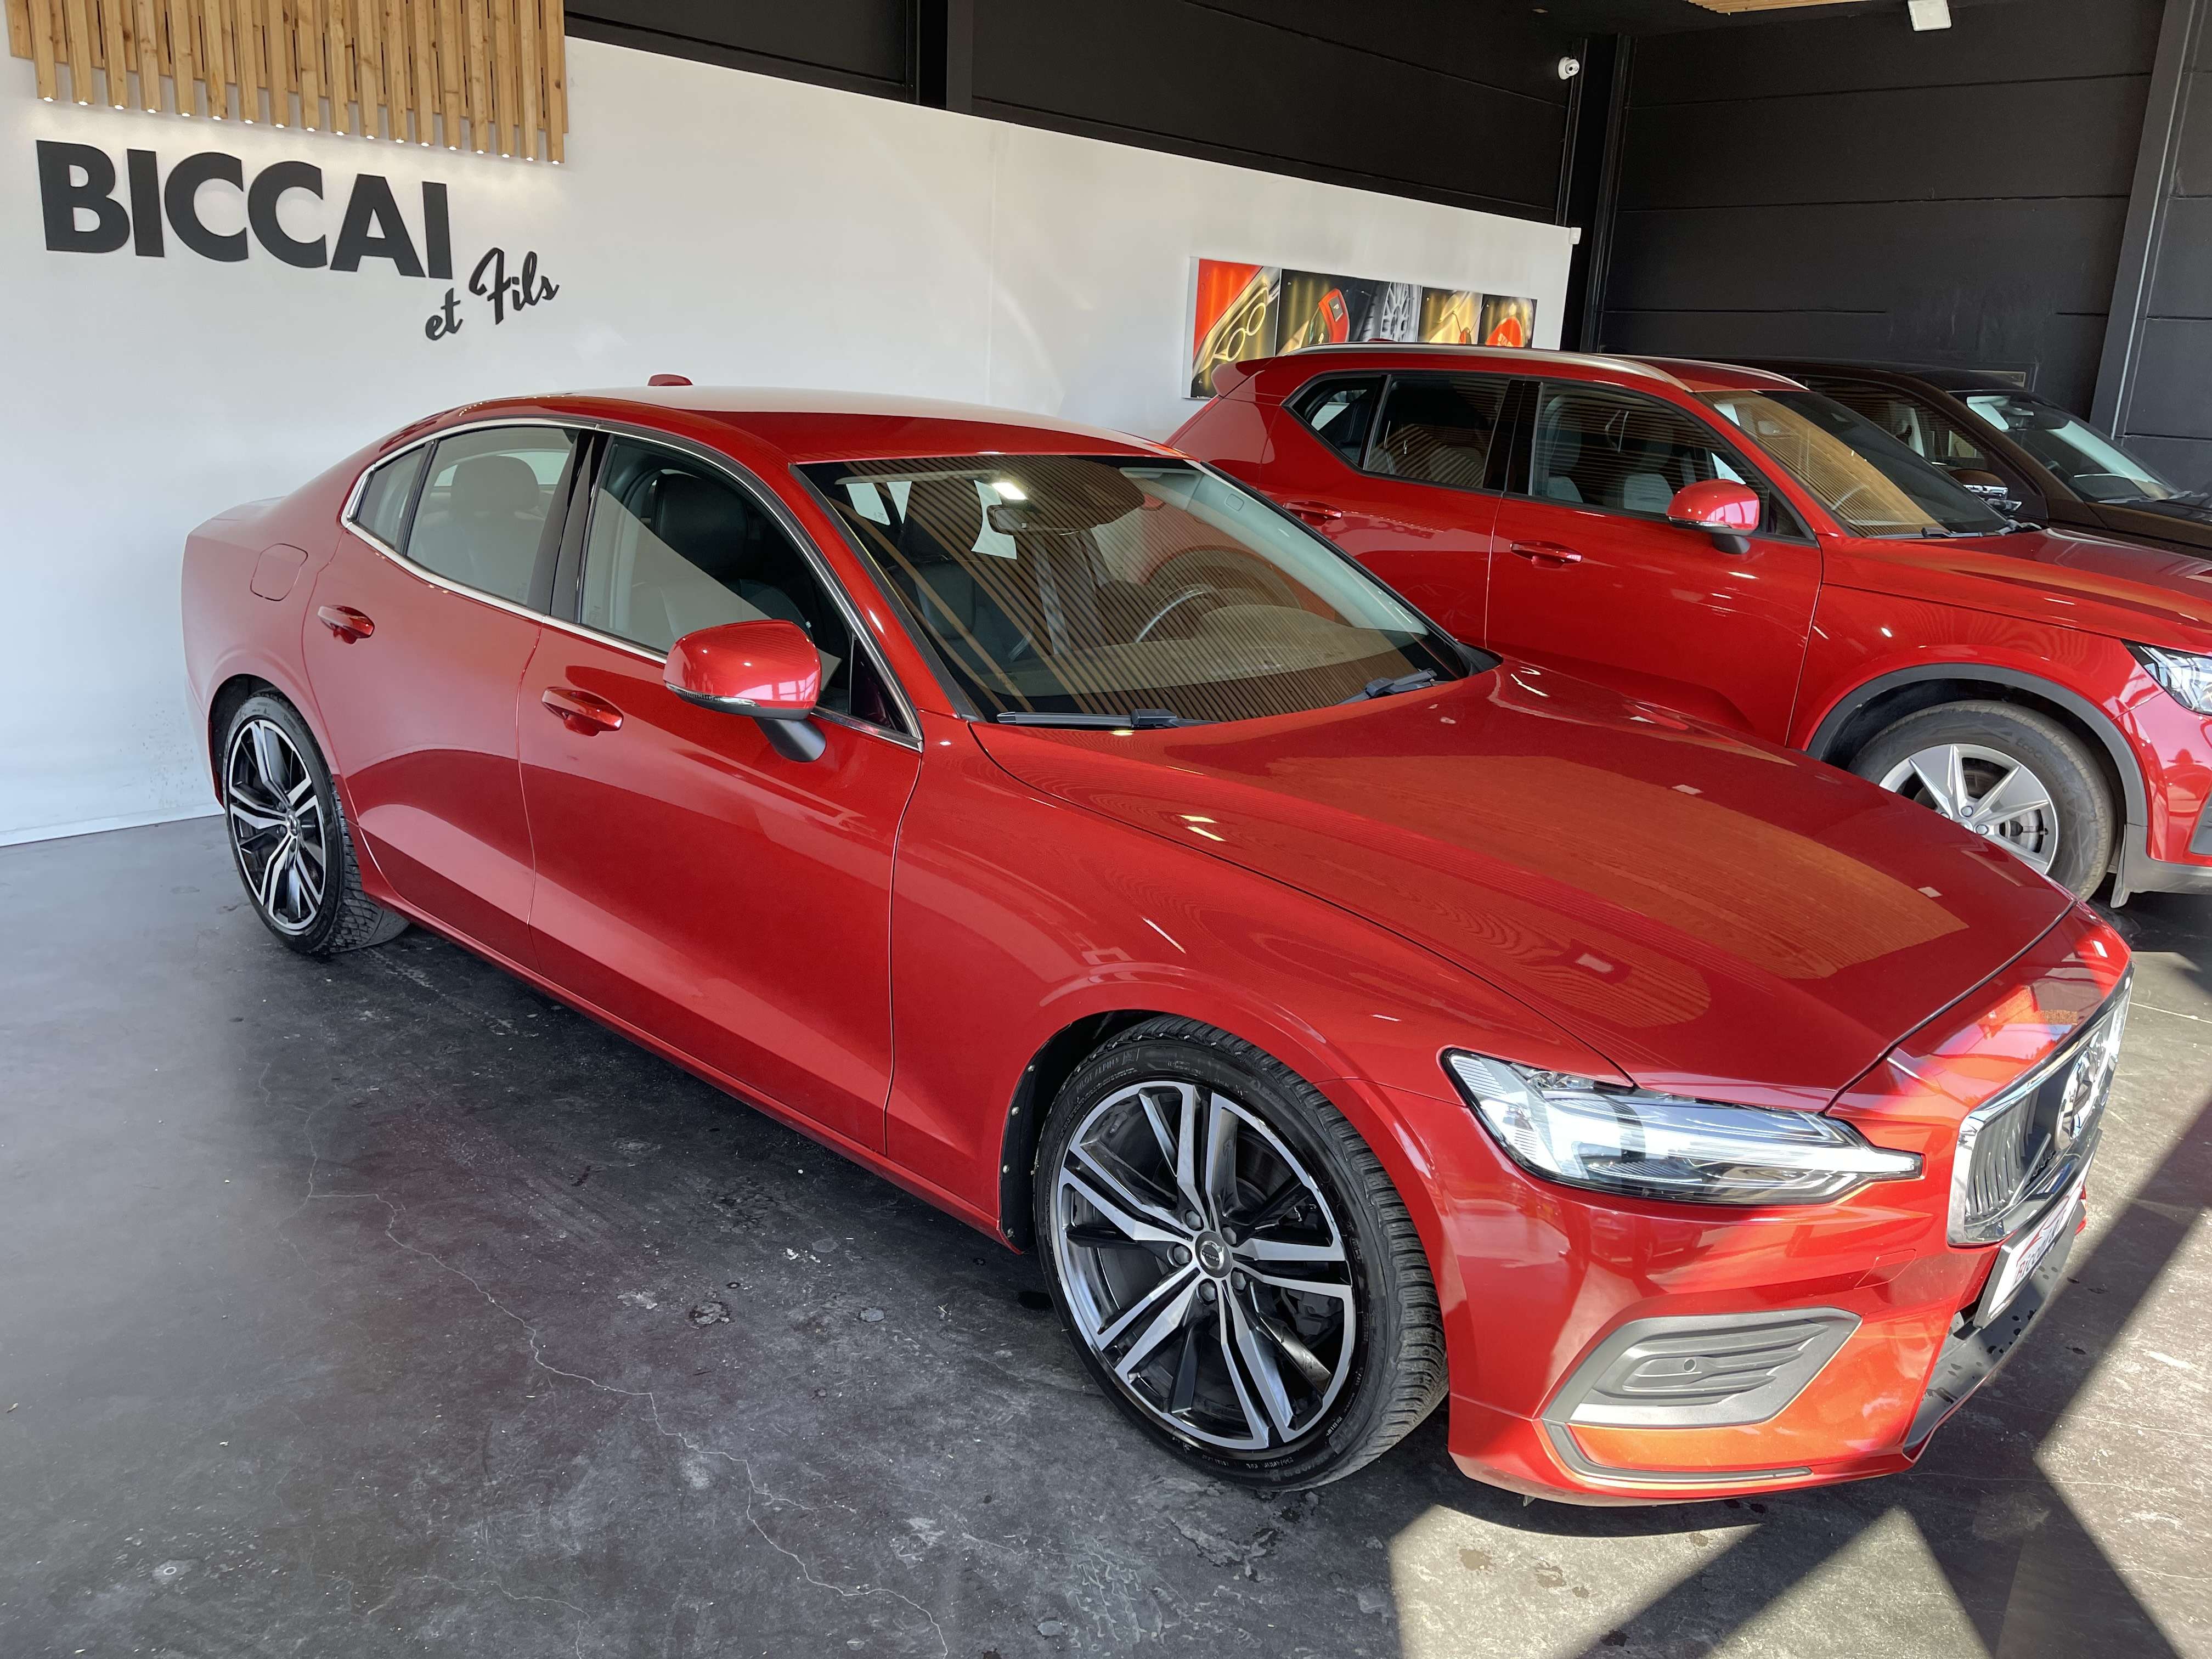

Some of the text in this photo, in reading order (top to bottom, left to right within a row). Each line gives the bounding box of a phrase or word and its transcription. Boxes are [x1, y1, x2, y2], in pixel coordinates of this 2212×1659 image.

[36, 140, 453, 279] BICCAI
[425, 247, 559, 340] et Fils
